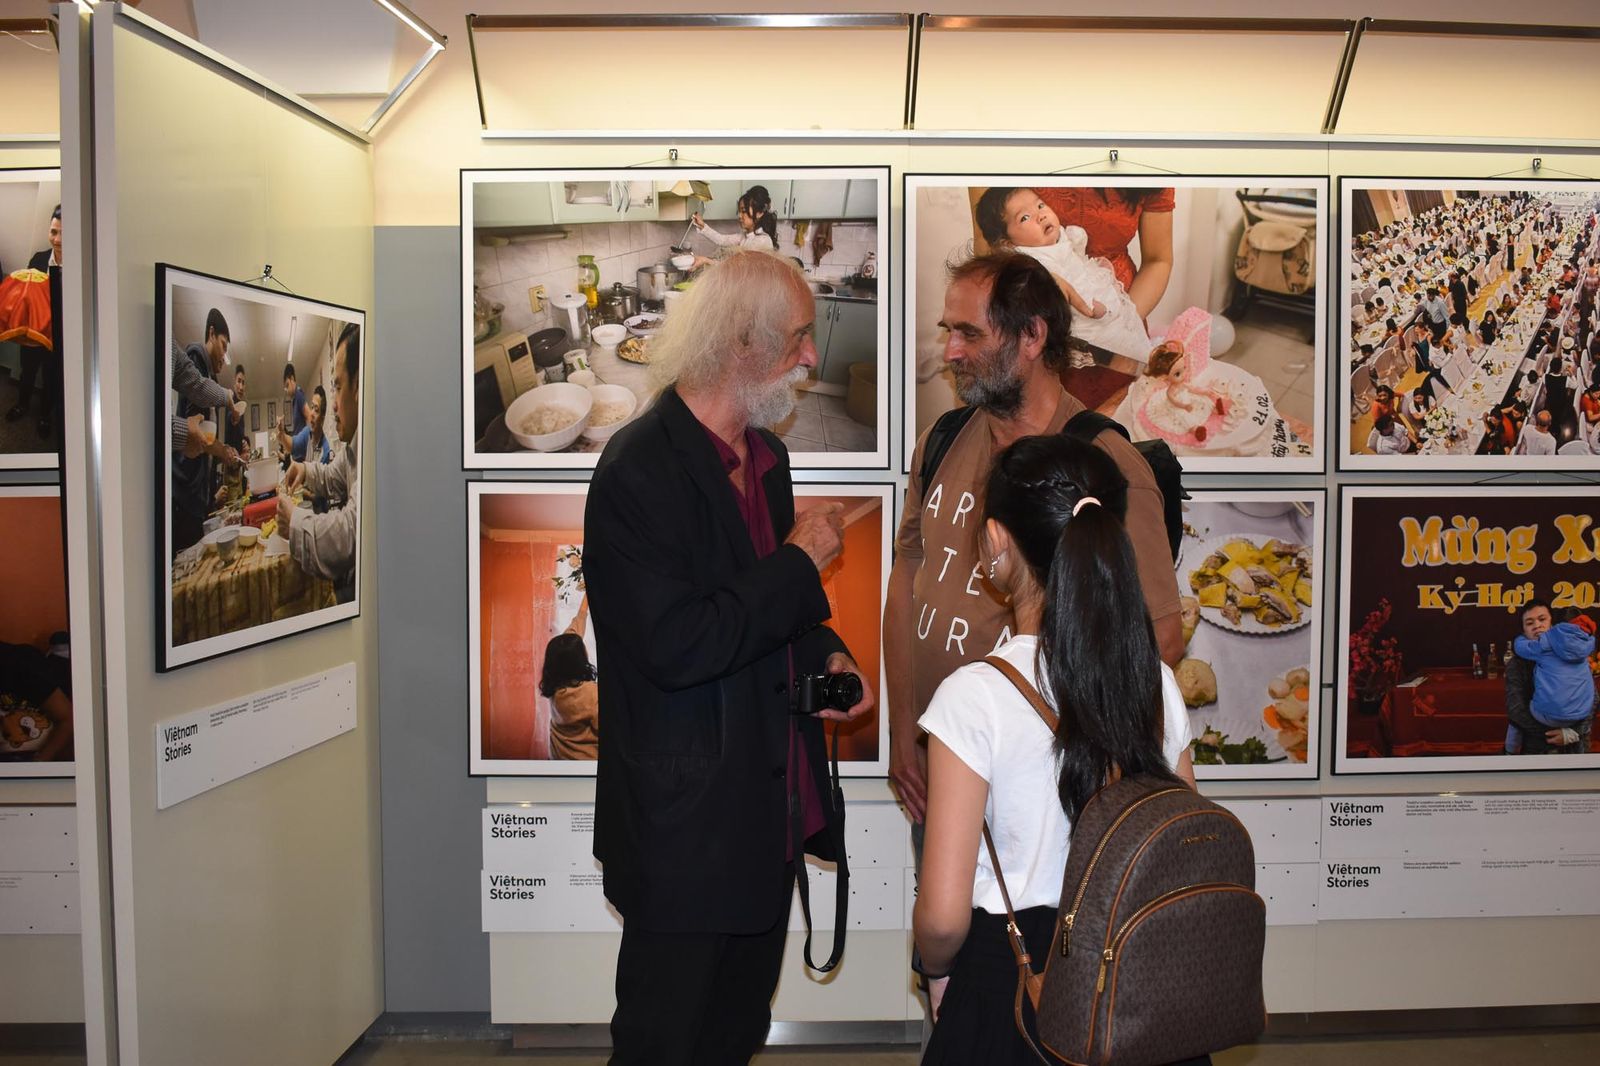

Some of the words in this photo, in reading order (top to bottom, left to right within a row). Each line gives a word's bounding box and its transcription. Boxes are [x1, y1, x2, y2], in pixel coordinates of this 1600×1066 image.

[921, 538, 984, 596] TE
[1550, 581, 1600, 609] 20
[165, 742, 192, 762] Stories
[1330, 815, 1373, 827] Stories
[491, 827, 536, 838] Stories
[1327, 876, 1369, 888] Stories
[489, 888, 535, 900] Stories
